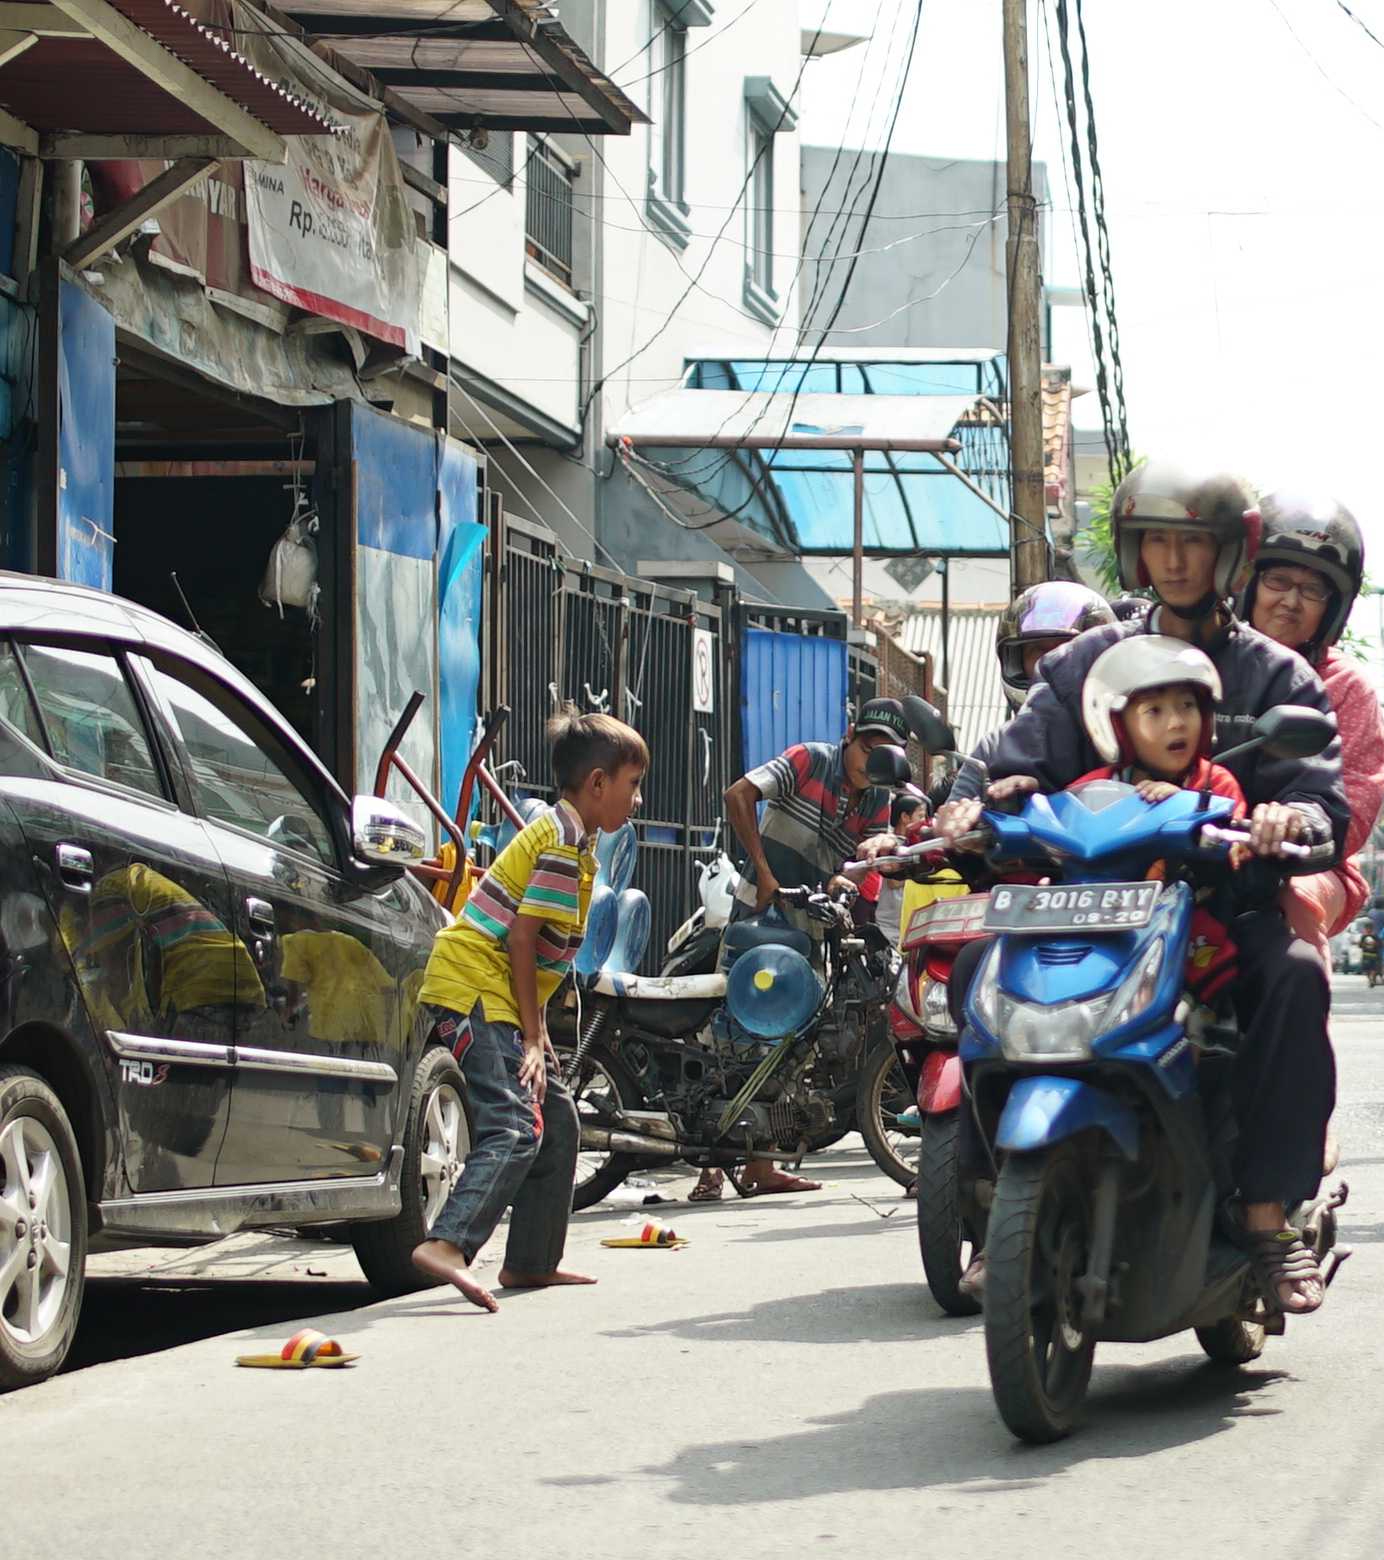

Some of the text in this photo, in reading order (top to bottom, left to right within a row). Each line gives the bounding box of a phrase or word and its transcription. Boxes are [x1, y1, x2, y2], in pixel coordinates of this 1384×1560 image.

[994, 890, 1013, 910] B
[1034, 889, 1094, 911] 3016
[119, 1058, 154, 1085] TRD
